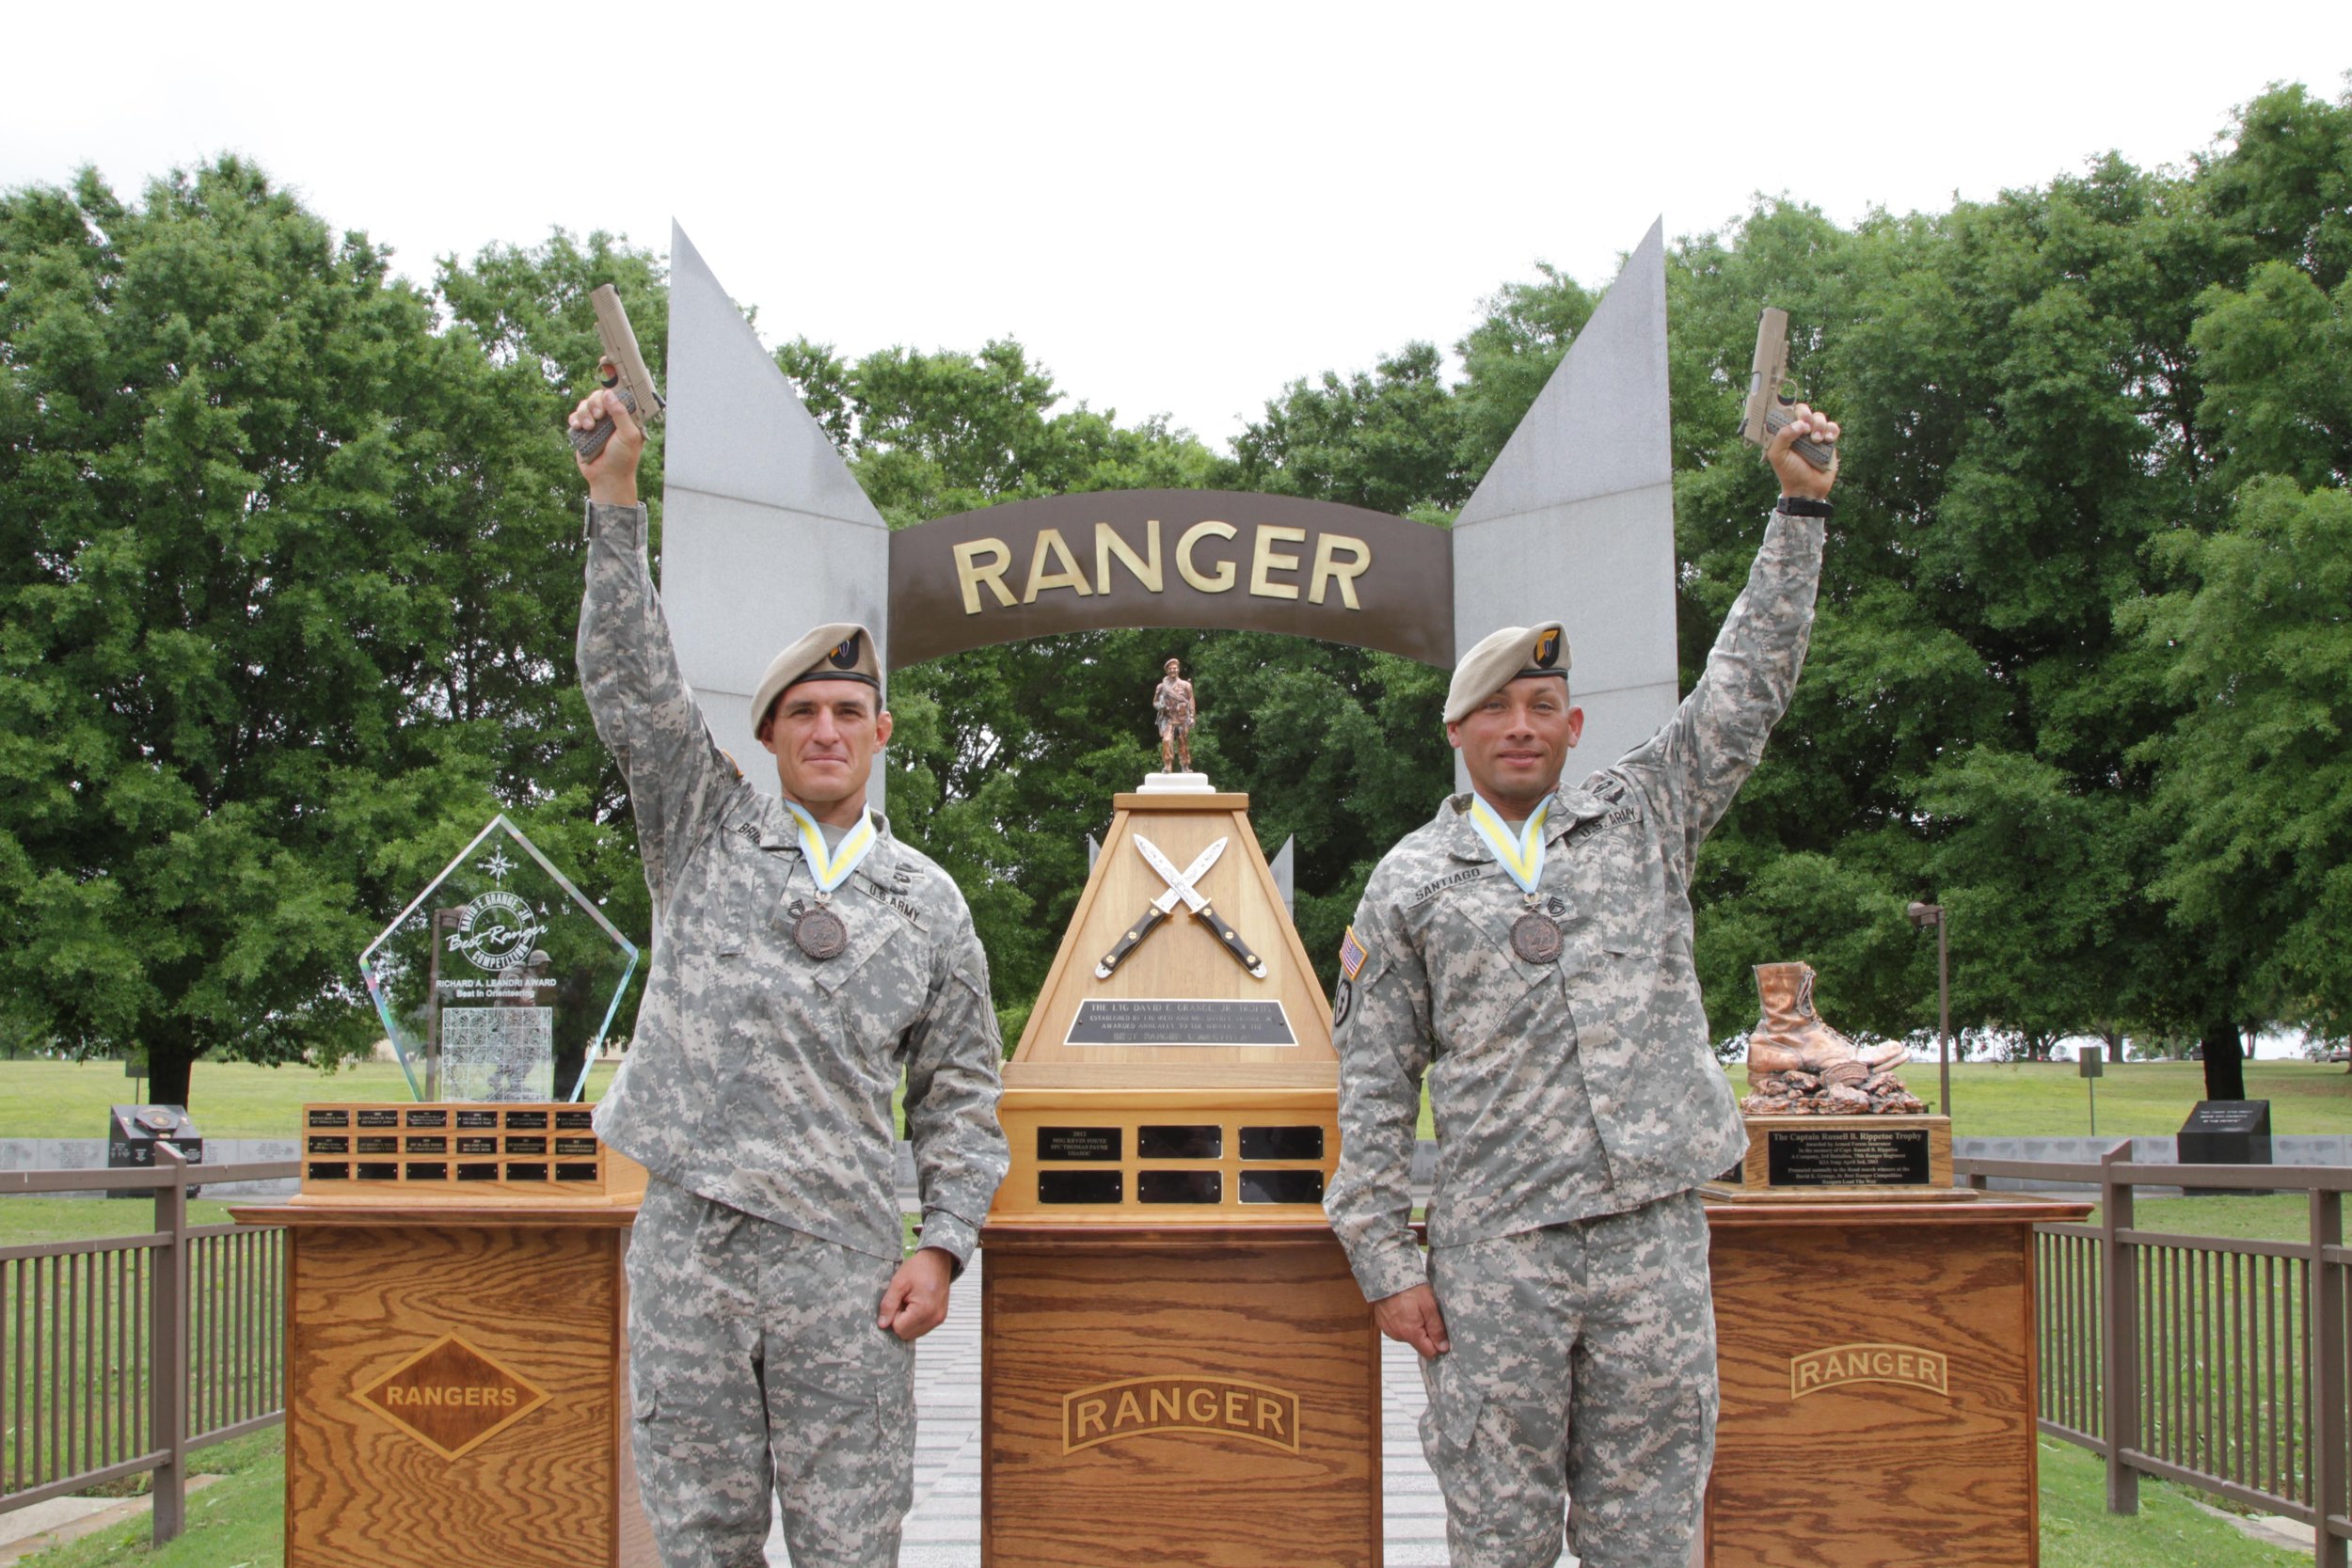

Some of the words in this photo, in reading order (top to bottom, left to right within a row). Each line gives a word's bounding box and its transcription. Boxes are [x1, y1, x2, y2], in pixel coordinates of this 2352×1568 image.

[952, 520, 1372, 615] RANGER
[1581, 821, 1607, 838] U.S.
[1608, 808, 1636, 825] ARMY
[1415, 868, 1480, 901] SANTIAGO
[869, 885, 888, 903] U.S.
[889, 897, 921, 923] ARMY
[461, 906, 478, 932] DAVID
[446, 930, 490, 951] Best
[489, 925, 548, 945] Ranger
[472, 943, 529, 968] COMPETITION
[436, 979, 474, 988] RICHARD
[486, 990, 535, 998] Orienteering
[1790, 1133, 1820, 1143] Captain
[1860, 1132, 1893, 1141] Rippetoe
[1894, 1132, 1922, 1141] Trophy
[1800, 1352, 1939, 1388] RANGER
[387, 1386, 516, 1406] RANGERS
[1077, 1387, 1285, 1438] RANGER
